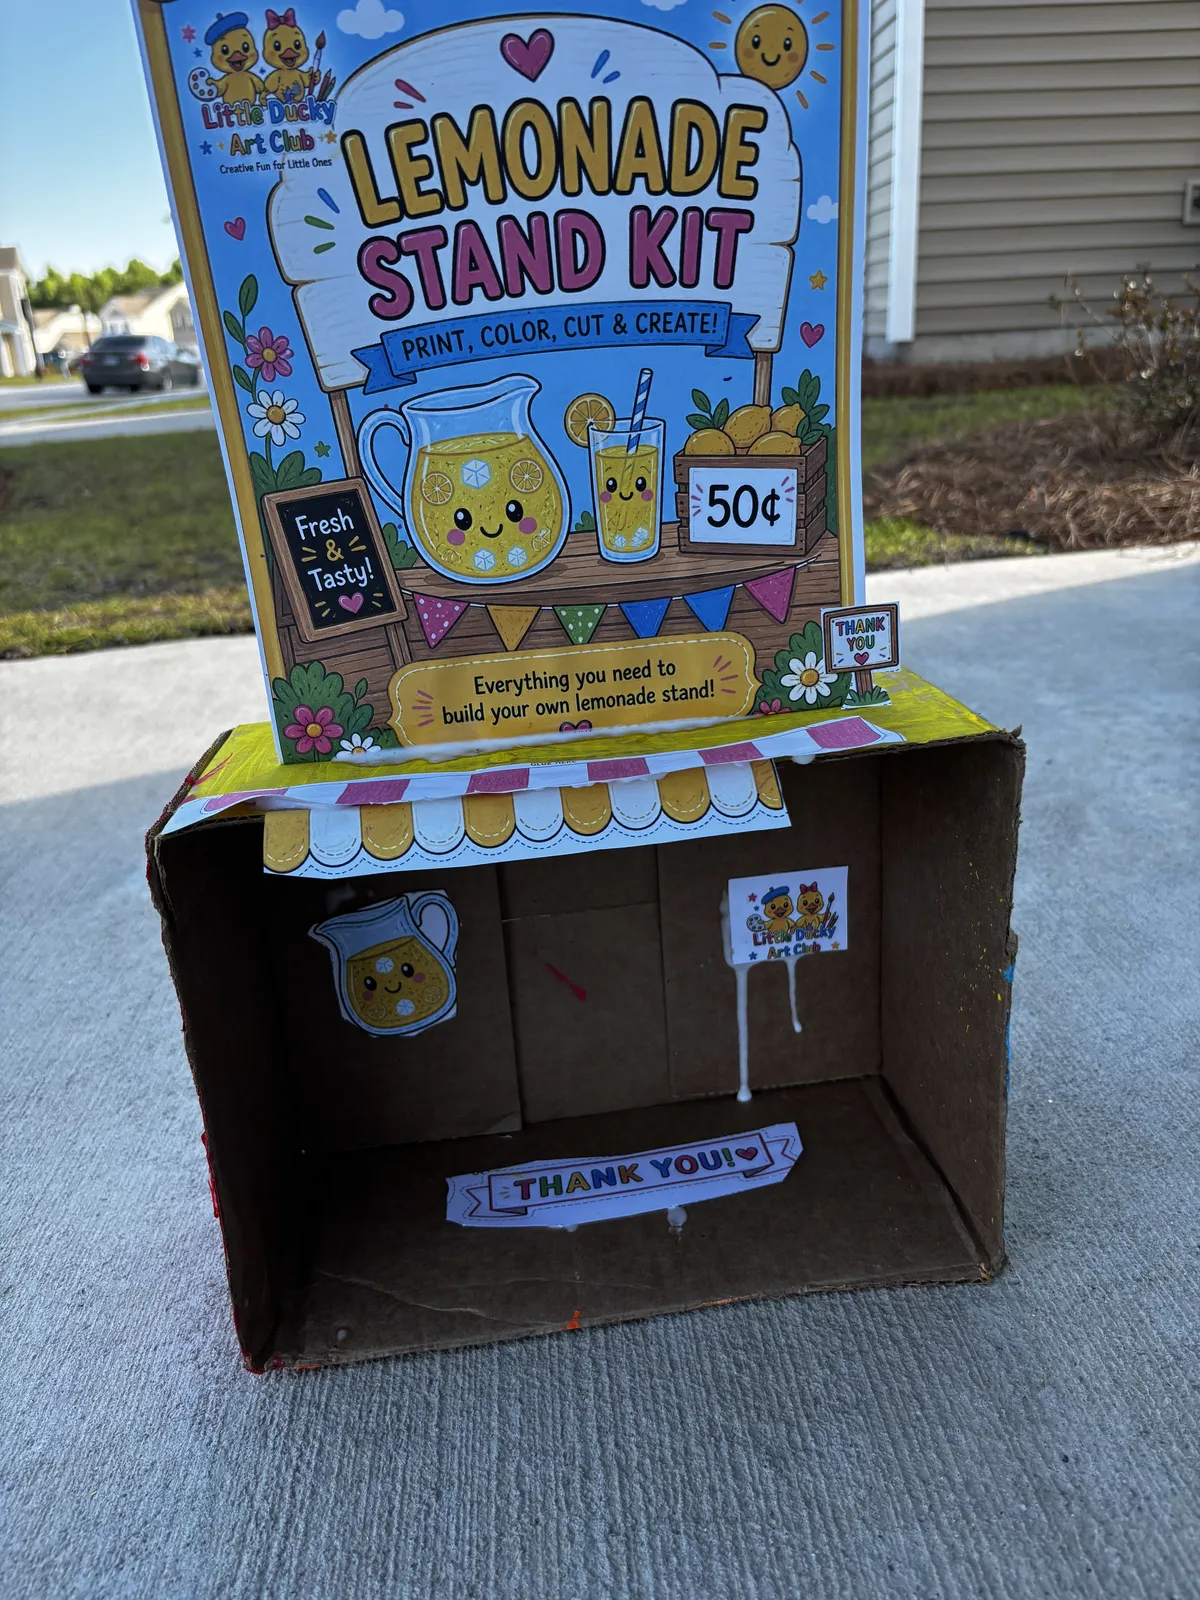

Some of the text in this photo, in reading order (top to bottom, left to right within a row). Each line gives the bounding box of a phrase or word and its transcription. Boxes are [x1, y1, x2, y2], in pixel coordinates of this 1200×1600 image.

[201, 97, 336, 130] Little Ducky
[229, 128, 315, 156] Art Club
[220, 158, 333, 174] Creative Fun for Little Ones
[340, 96, 768, 228] LEMONADE
[357, 205, 755, 321] STAND KIT
[401, 310, 718, 362] PRINT, COLOR, CUT & CREATE!
[706, 484, 781, 528] 50¢
[295, 508, 355, 541] Fresh
[326, 539, 345, 562] &
[307, 556, 375, 592] Tasty!
[835, 616, 885, 637] THANK
[847, 635, 876, 652] YOU
[473, 659, 676, 697] Everything you need to
[441, 679, 715, 726] build your own lemonade stand!
[752, 925, 837, 946] Little Ducky
[767, 941, 821, 960] Art Club
[514, 1147, 735, 1201] THANK YOU!
